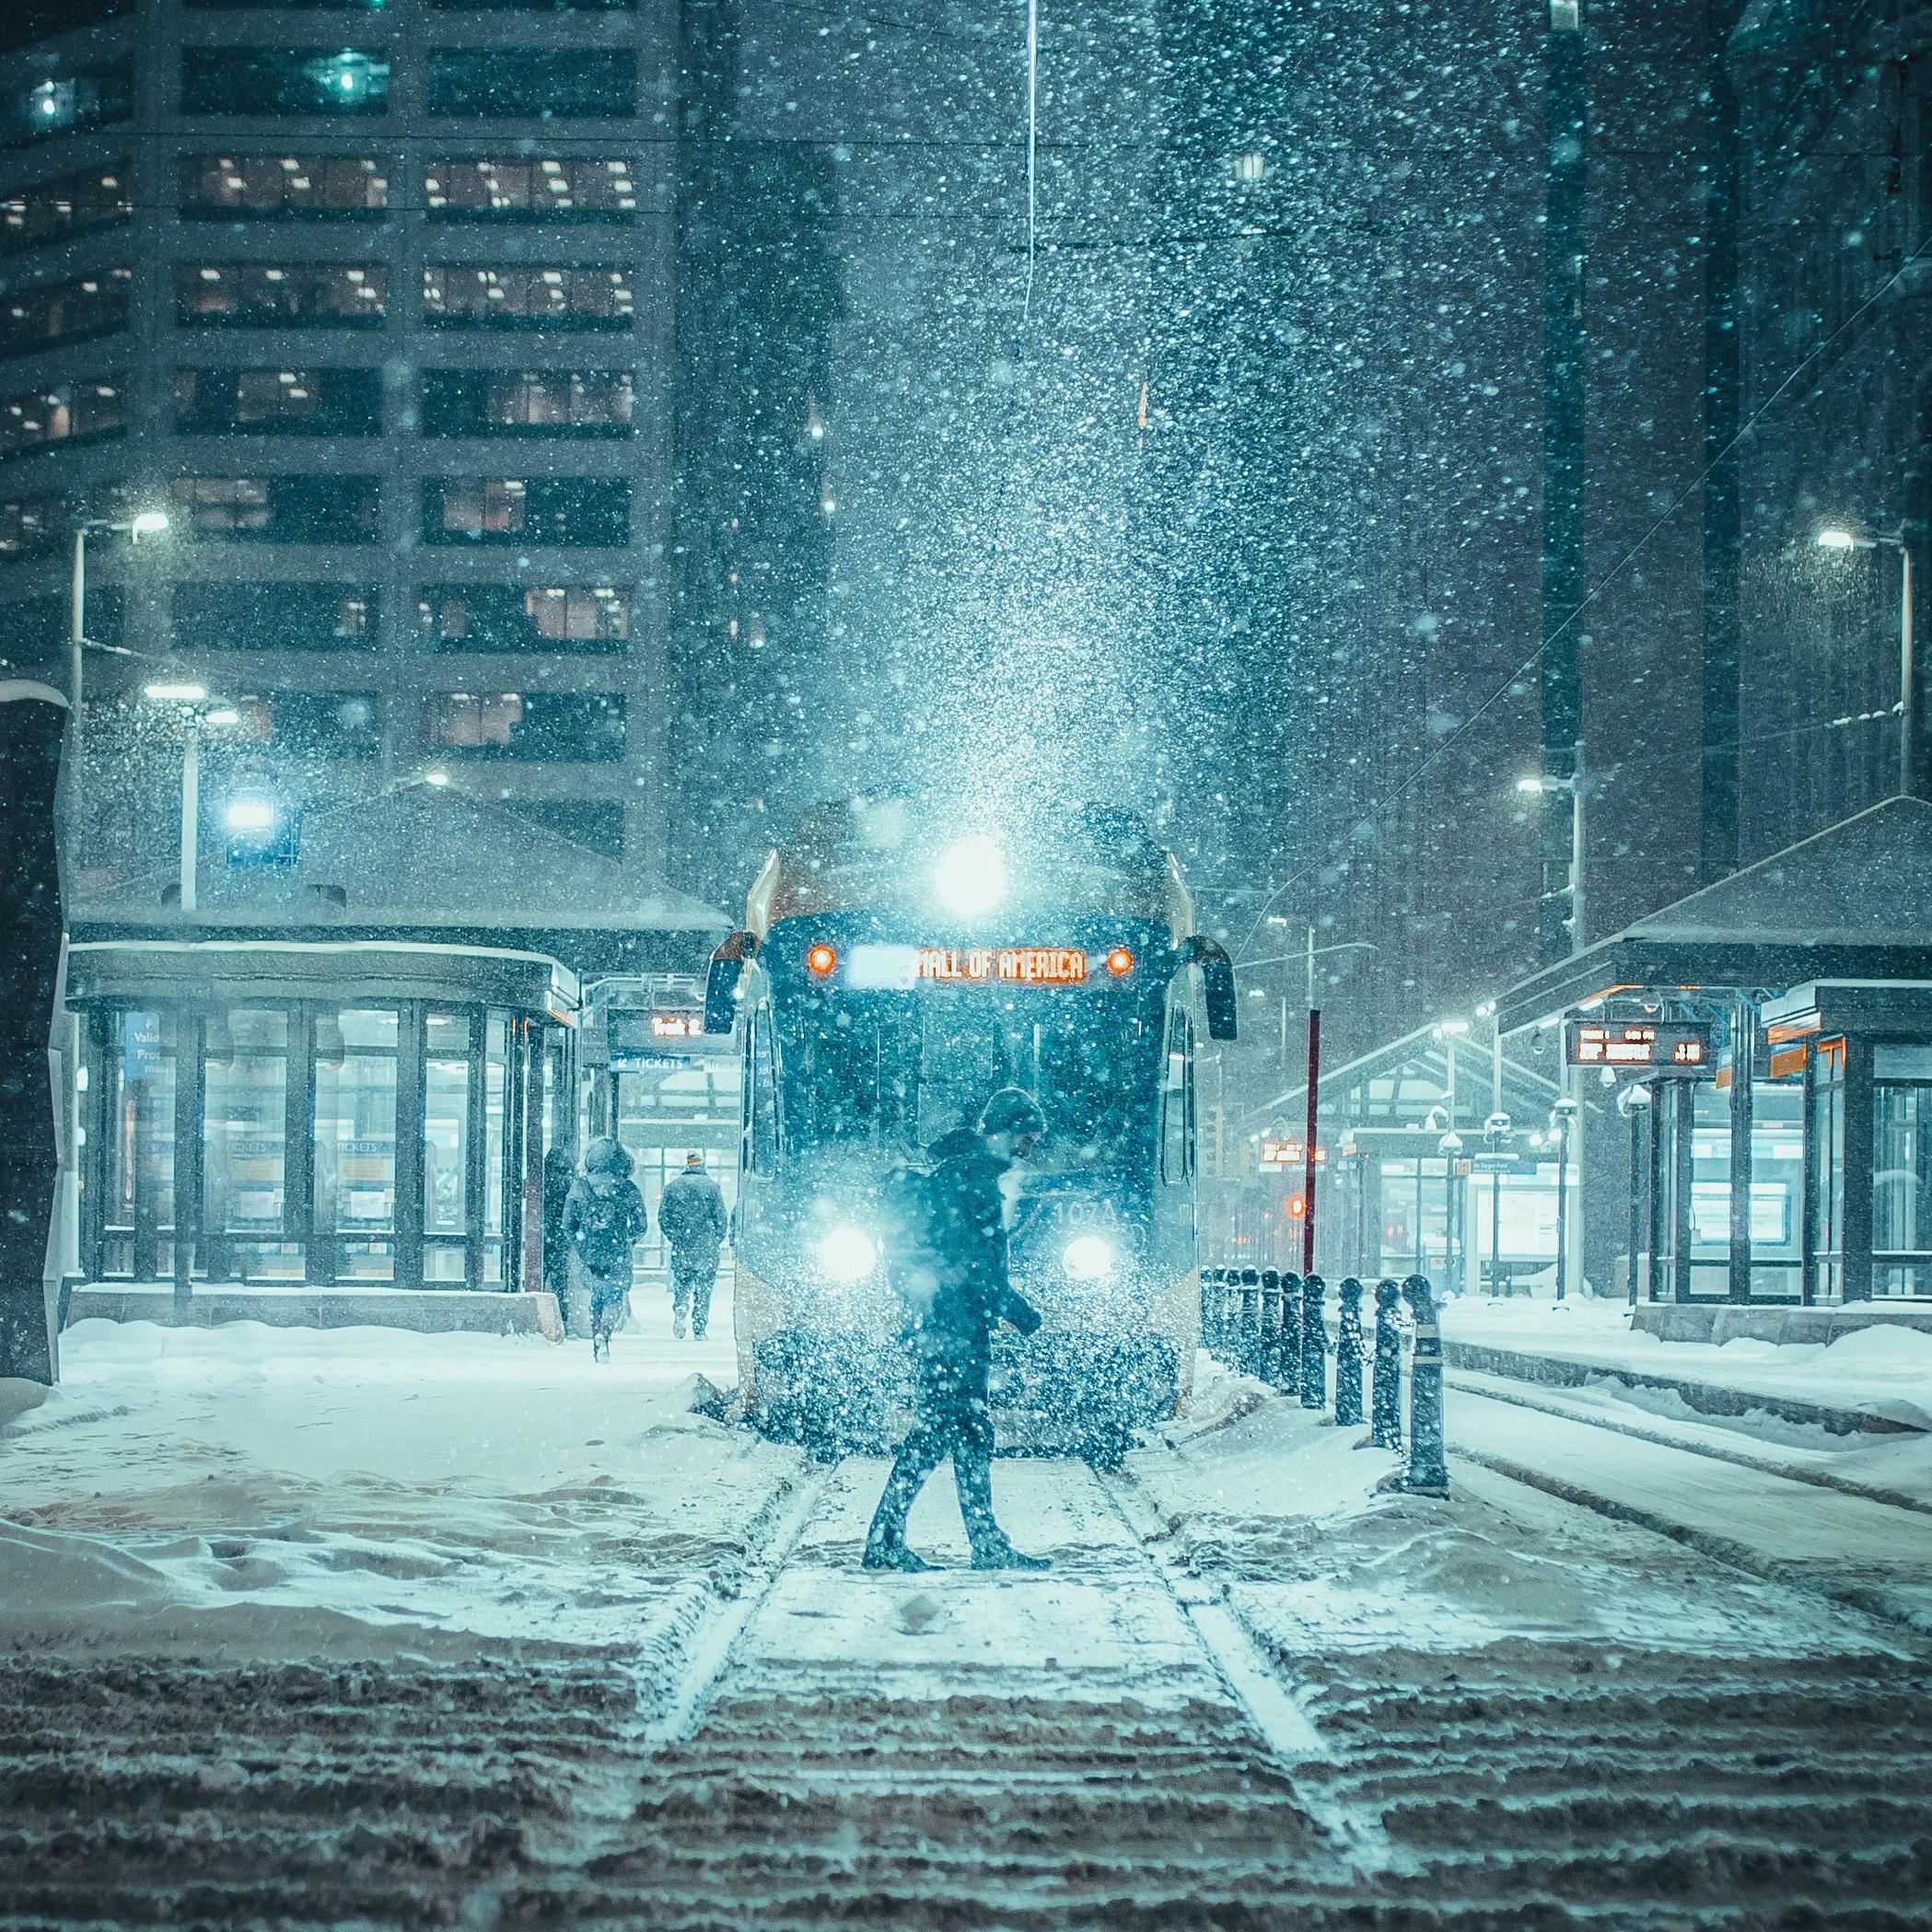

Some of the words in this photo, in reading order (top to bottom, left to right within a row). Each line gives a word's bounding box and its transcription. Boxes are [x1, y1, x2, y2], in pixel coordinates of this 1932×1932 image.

[914, 951, 961, 977] MALL
[968, 951, 992, 977] OF
[999, 951, 1083, 978] AMERICA
[634, 1058, 683, 1069] TICKETS
[1053, 1199, 1119, 1225] 107A
